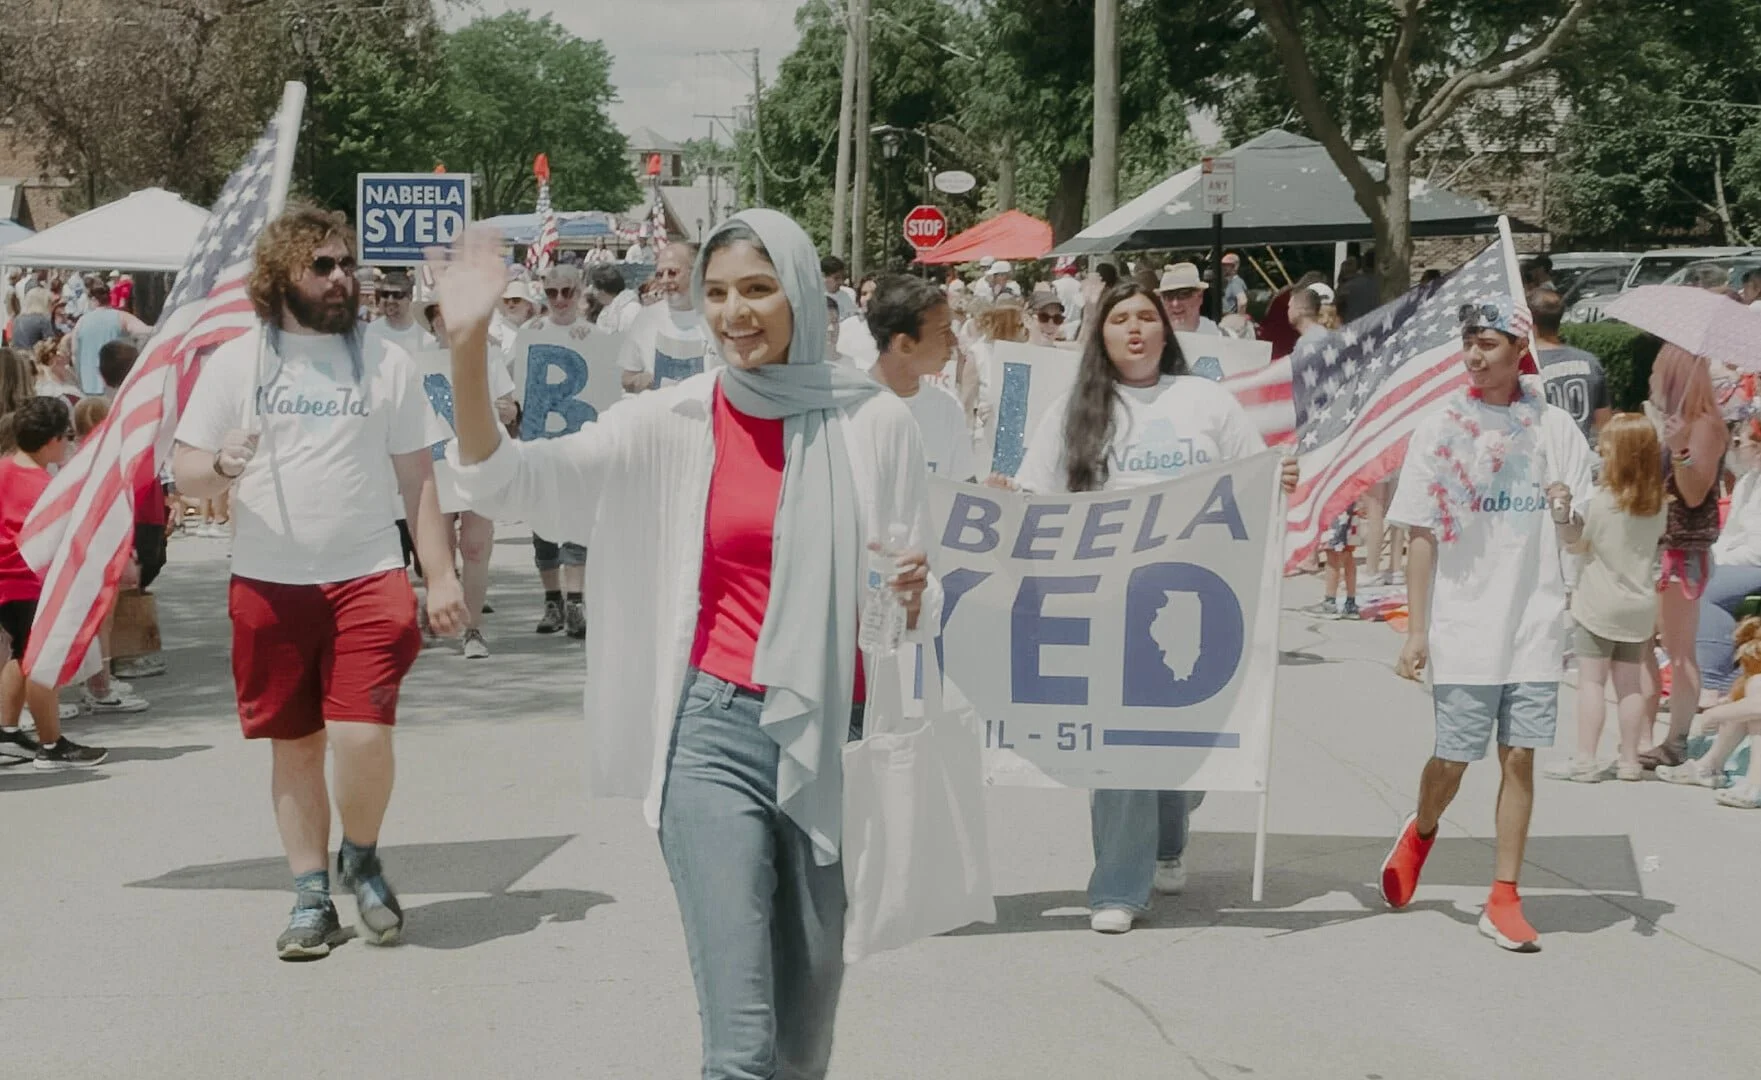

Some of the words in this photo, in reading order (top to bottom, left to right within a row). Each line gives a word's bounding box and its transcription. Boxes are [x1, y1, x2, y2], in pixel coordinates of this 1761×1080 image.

[365, 185, 463, 206] NABEELA
[364, 208, 465, 244] SYED
[908, 219, 943, 237] STOP
[519, 343, 598, 442] B
[940, 473, 1250, 561] BEELA
[985, 719, 1015, 750] IL
[1056, 722, 1093, 751] 51
